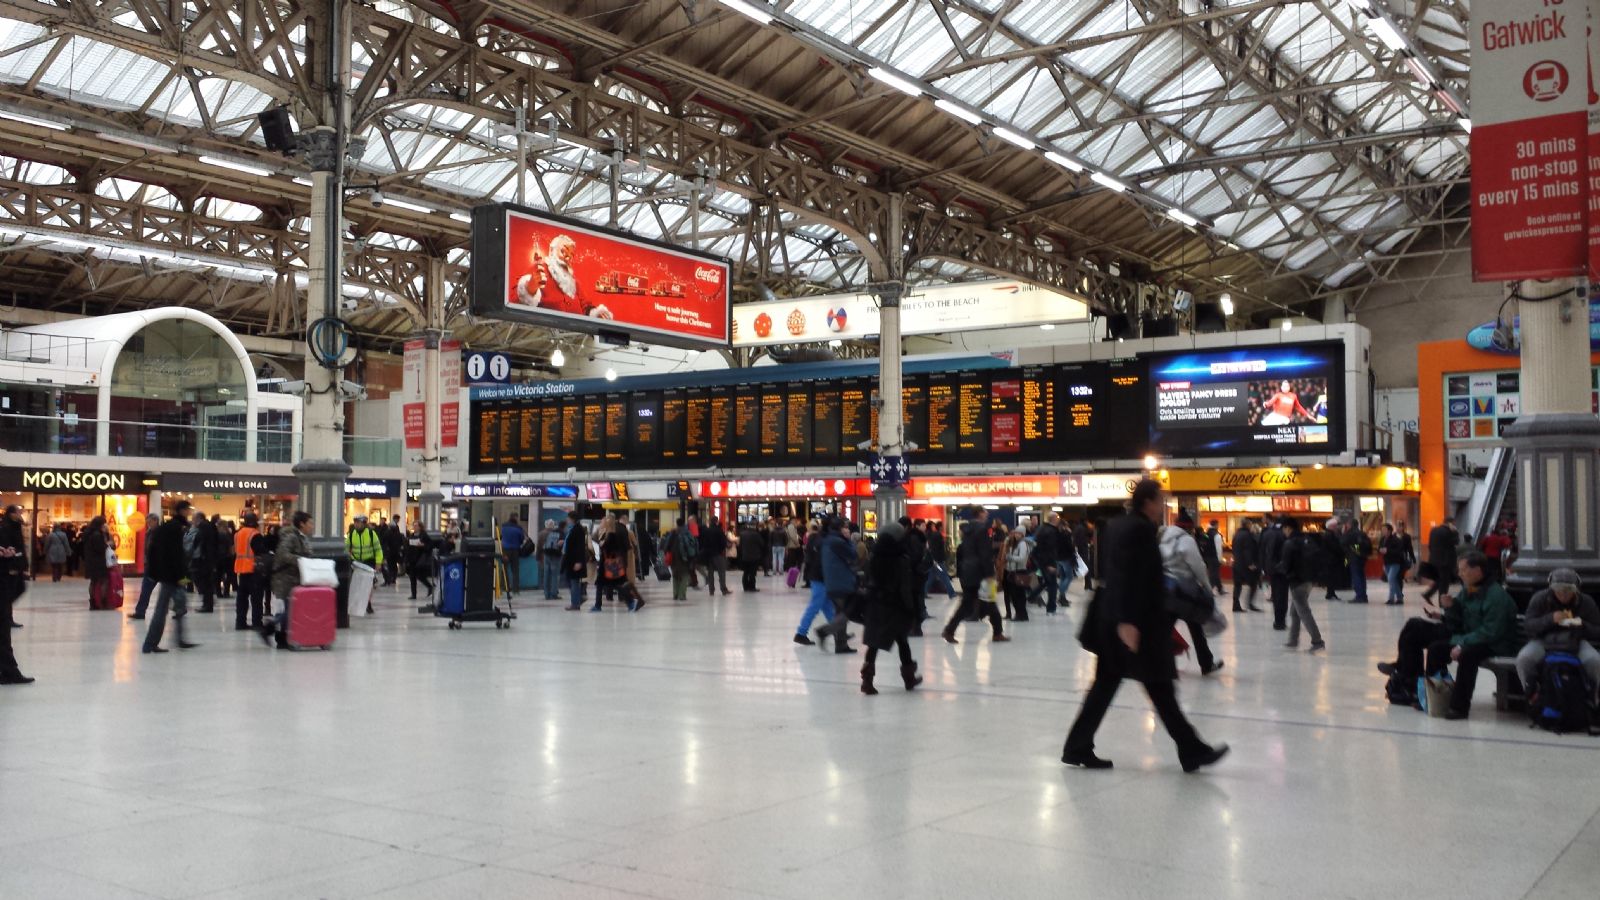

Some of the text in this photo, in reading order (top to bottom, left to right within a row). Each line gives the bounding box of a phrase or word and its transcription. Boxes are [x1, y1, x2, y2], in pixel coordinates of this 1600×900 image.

[1483, 10, 1566, 51] Gatwick
[1517, 137, 1576, 159] 30 mins
[1511, 160, 1578, 181] non-stop
[1479, 181, 1579, 207] every 15 mins
[1527, 211, 1581, 226] Book online at
[924, 301, 935, 309] TO
[937, 299, 951, 308] THE
[953, 297, 980, 307] BEACH
[479, 382, 575, 398] Welcome to Victoria Station
[1191, 390, 1213, 399] FANCY
[1214, 389, 1238, 398] DRESS
[1159, 399, 1191, 407] APOLOGY
[23, 471, 126, 490] MONSOON
[203, 480, 268, 490] OLIVER BONAS
[1219, 470, 1300, 488] Upper Crust
[473, 485, 542, 496] Rail Information
[668, 485, 677, 495] 12
[727, 480, 826, 496] BURGER KING
[1063, 480, 1079, 495] 13
